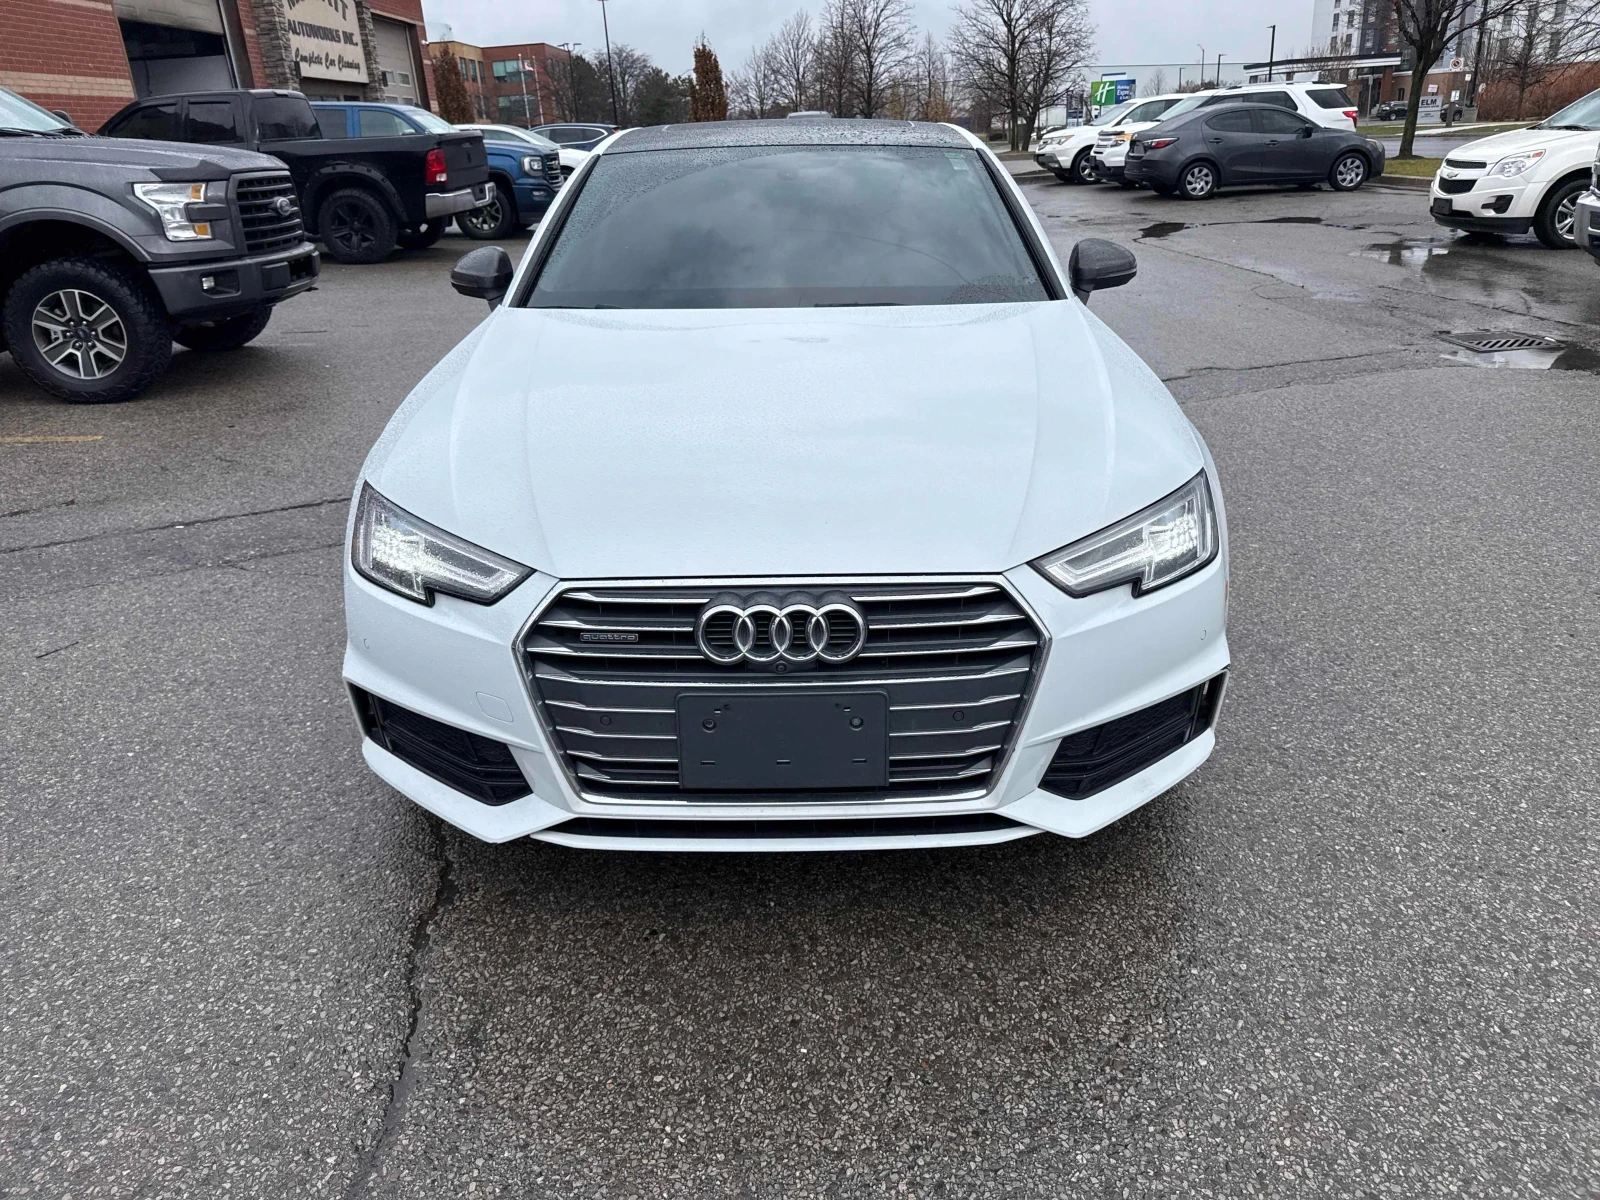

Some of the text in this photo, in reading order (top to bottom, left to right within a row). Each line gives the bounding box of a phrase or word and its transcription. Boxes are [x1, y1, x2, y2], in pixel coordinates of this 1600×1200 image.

[288, 19, 358, 46] AUTOWORKS INC.
[295, 47, 360, 74] Complete Car Cleaning
[1421, 98, 1437, 106] ELM
[582, 633, 636, 641] quattro
